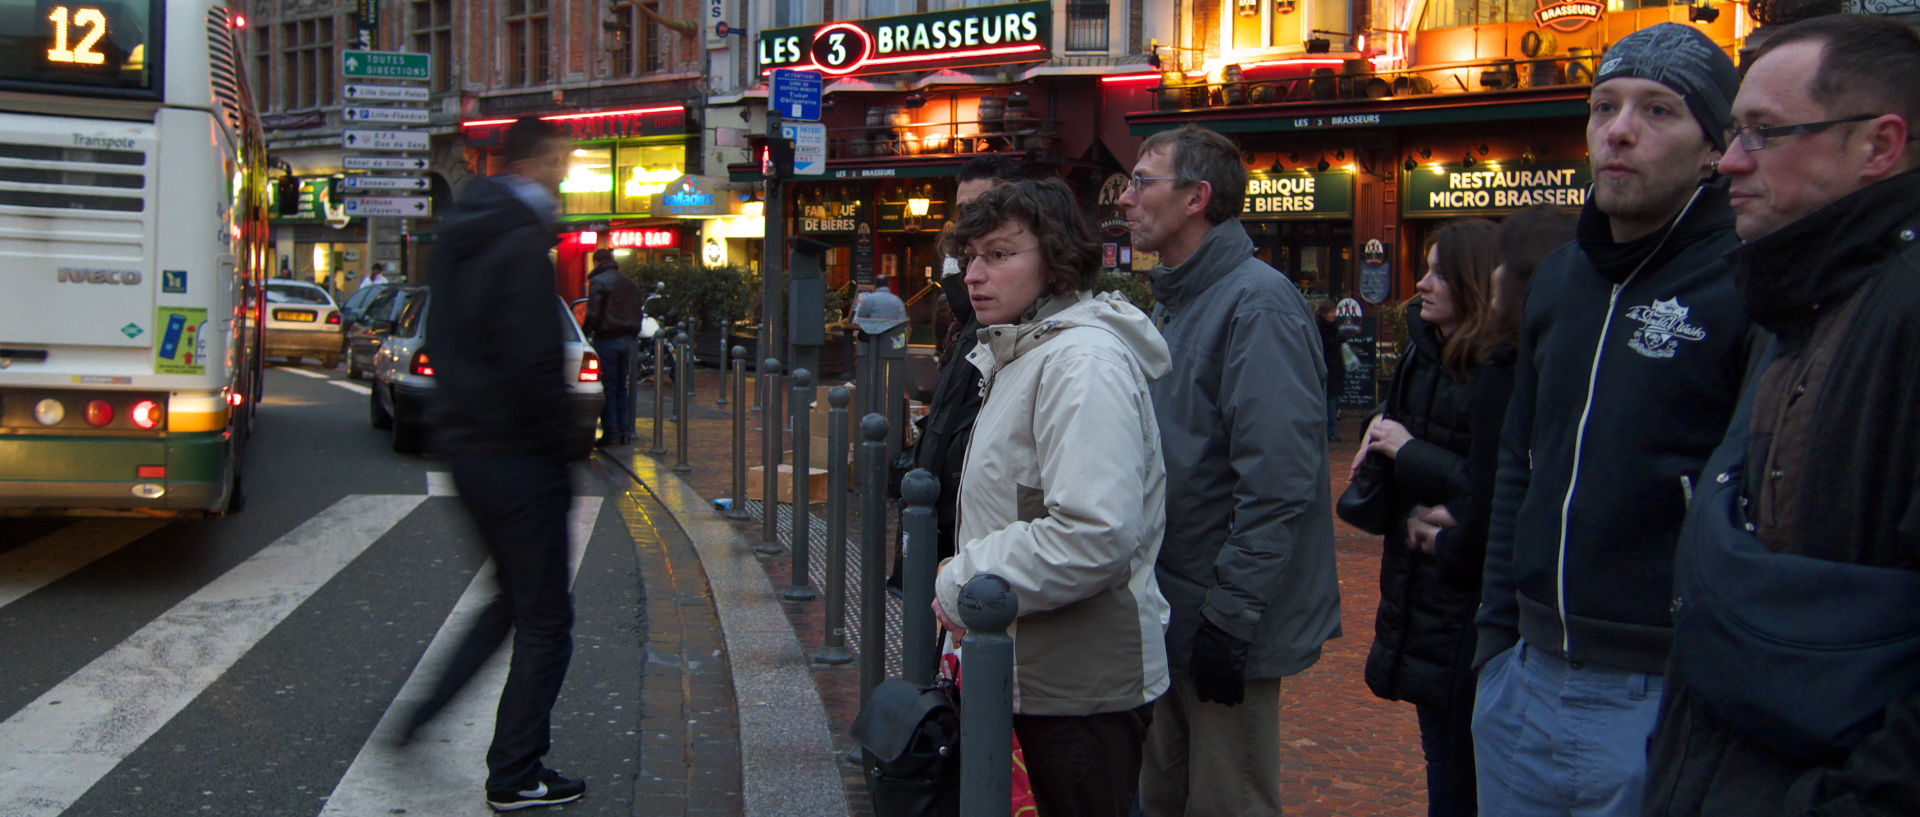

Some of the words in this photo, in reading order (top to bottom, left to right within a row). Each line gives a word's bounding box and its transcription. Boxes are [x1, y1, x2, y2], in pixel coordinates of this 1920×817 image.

[1541, 4, 1597, 21] BRASSEURS
[47, 6, 106, 64] 12
[760, 36, 800, 65] LES
[827, 33, 847, 65] 3
[878, 11, 1038, 53] BRASSEURS
[366, 54, 405, 65] TOUTES
[366, 65, 426, 76] DIRECTIONS
[379, 89, 401, 97] Grand
[404, 90, 428, 99] Palais
[1294, 118, 1308, 127] LES
[1332, 114, 1380, 125] BRASSEURS
[71, 133, 136, 149] Transpole
[836, 170, 846, 178] LES
[861, 169, 896, 177] BRASSEURS
[1450, 169, 1576, 189] RESTAURANT
[1245, 177, 1316, 196] BRIQUE
[1255, 196, 1315, 212] BIERES
[1429, 191, 1489, 208] MICRO
[1494, 188, 1585, 207] BRASSERI
[805, 220, 818, 231] DE
[821, 219, 855, 231] BIERES
[645, 231, 672, 246] BAR
[58, 267, 142, 285] IVECO
